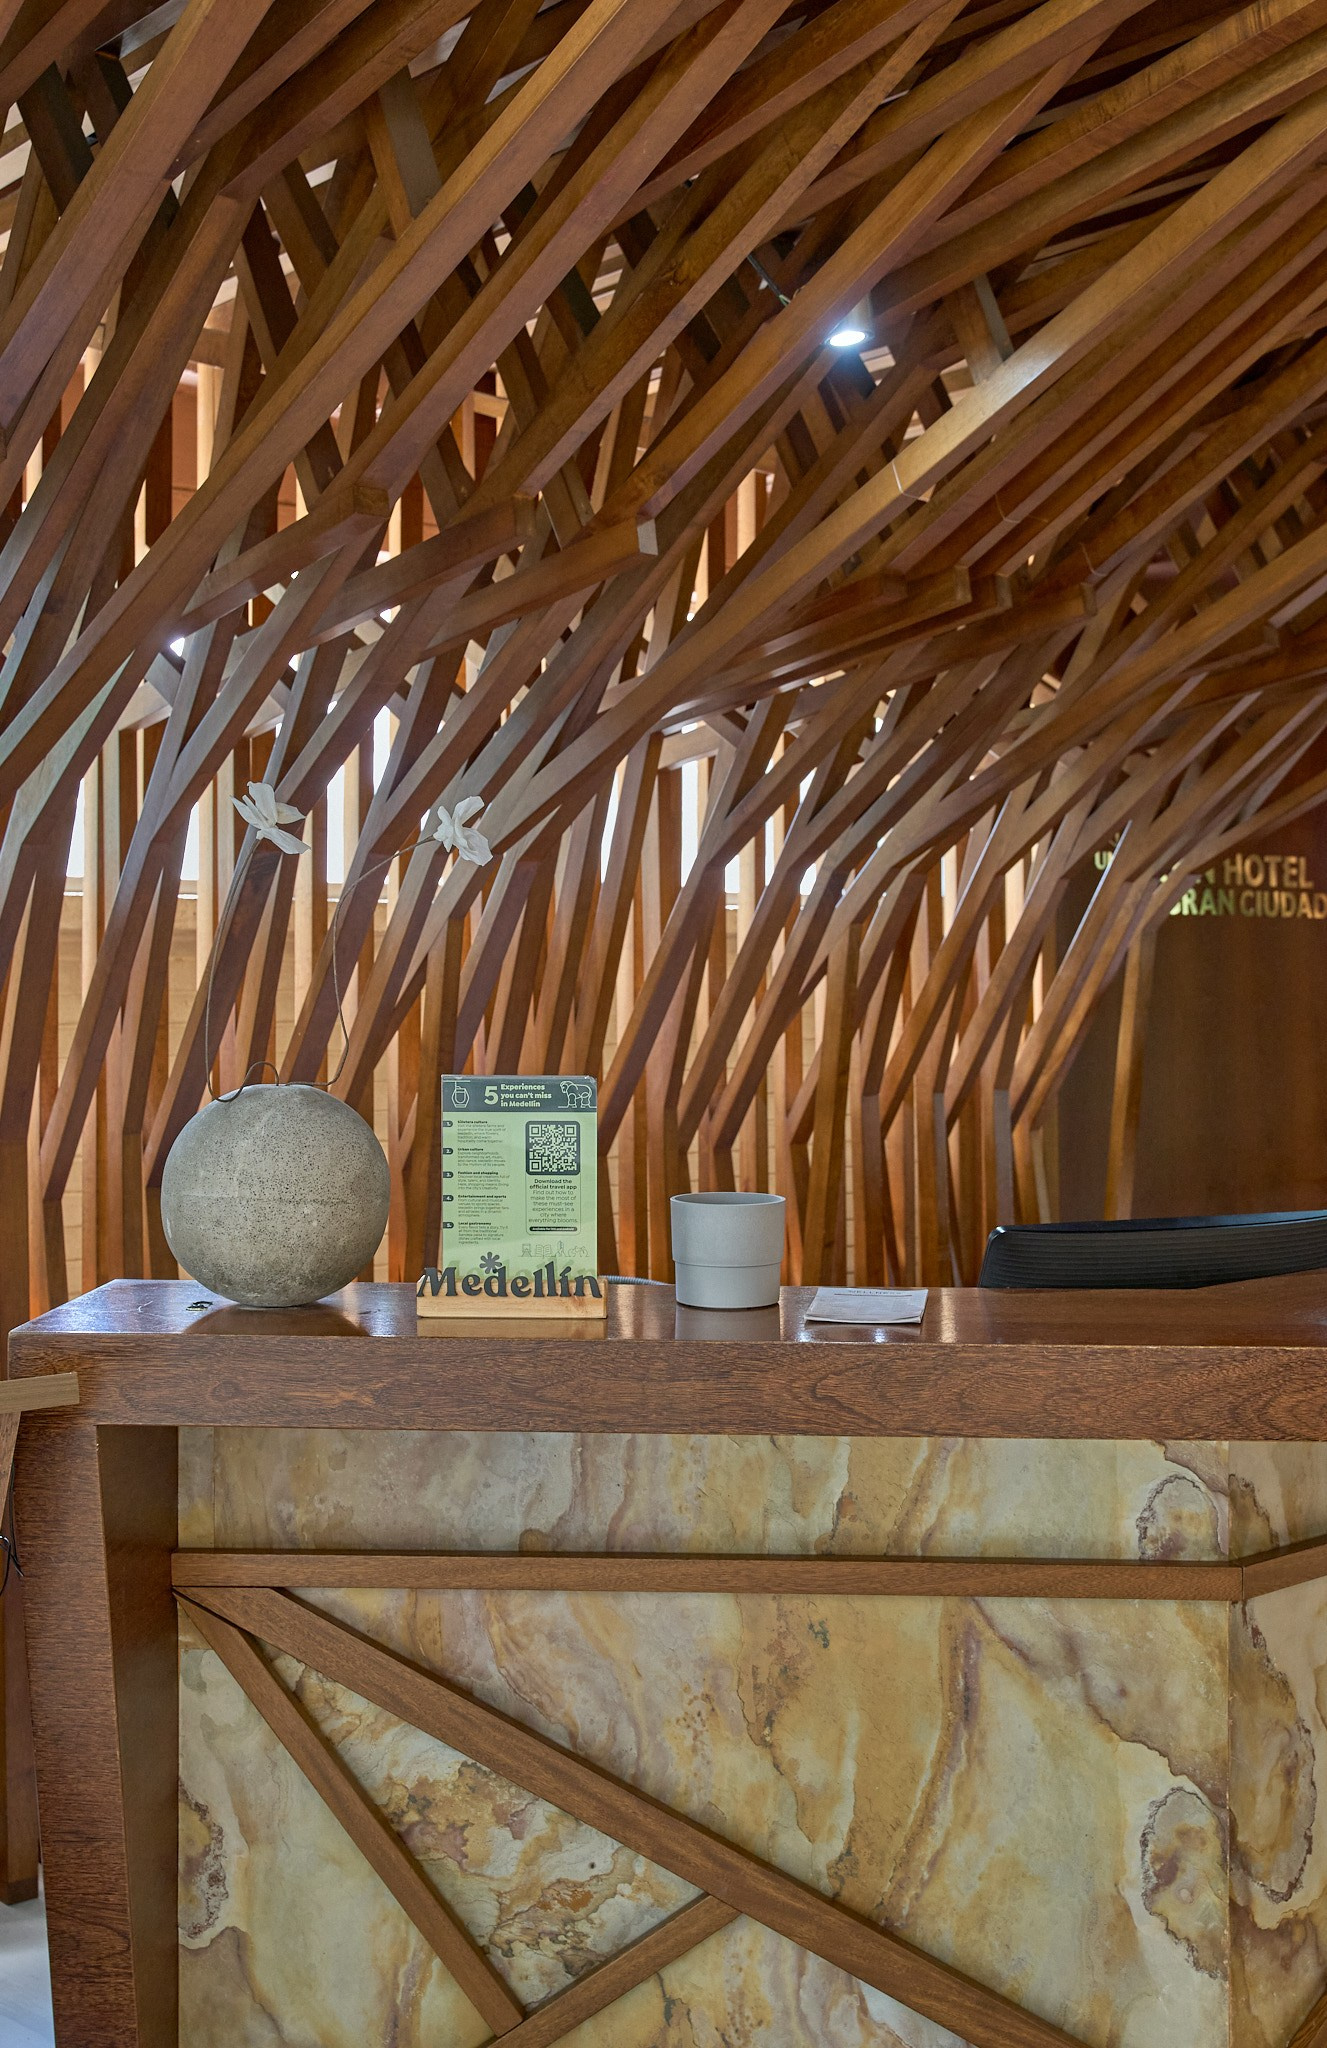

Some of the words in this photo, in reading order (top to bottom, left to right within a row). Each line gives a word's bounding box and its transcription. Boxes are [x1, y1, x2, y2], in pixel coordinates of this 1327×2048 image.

[1223, 853, 1314, 889] HOTEL
[1241, 889, 1327, 919] CIUDAD
[484, 1086, 498, 1104] 5
[500, 1082, 546, 1091] Experiences
[416, 1260, 602, 1298] Medellín
